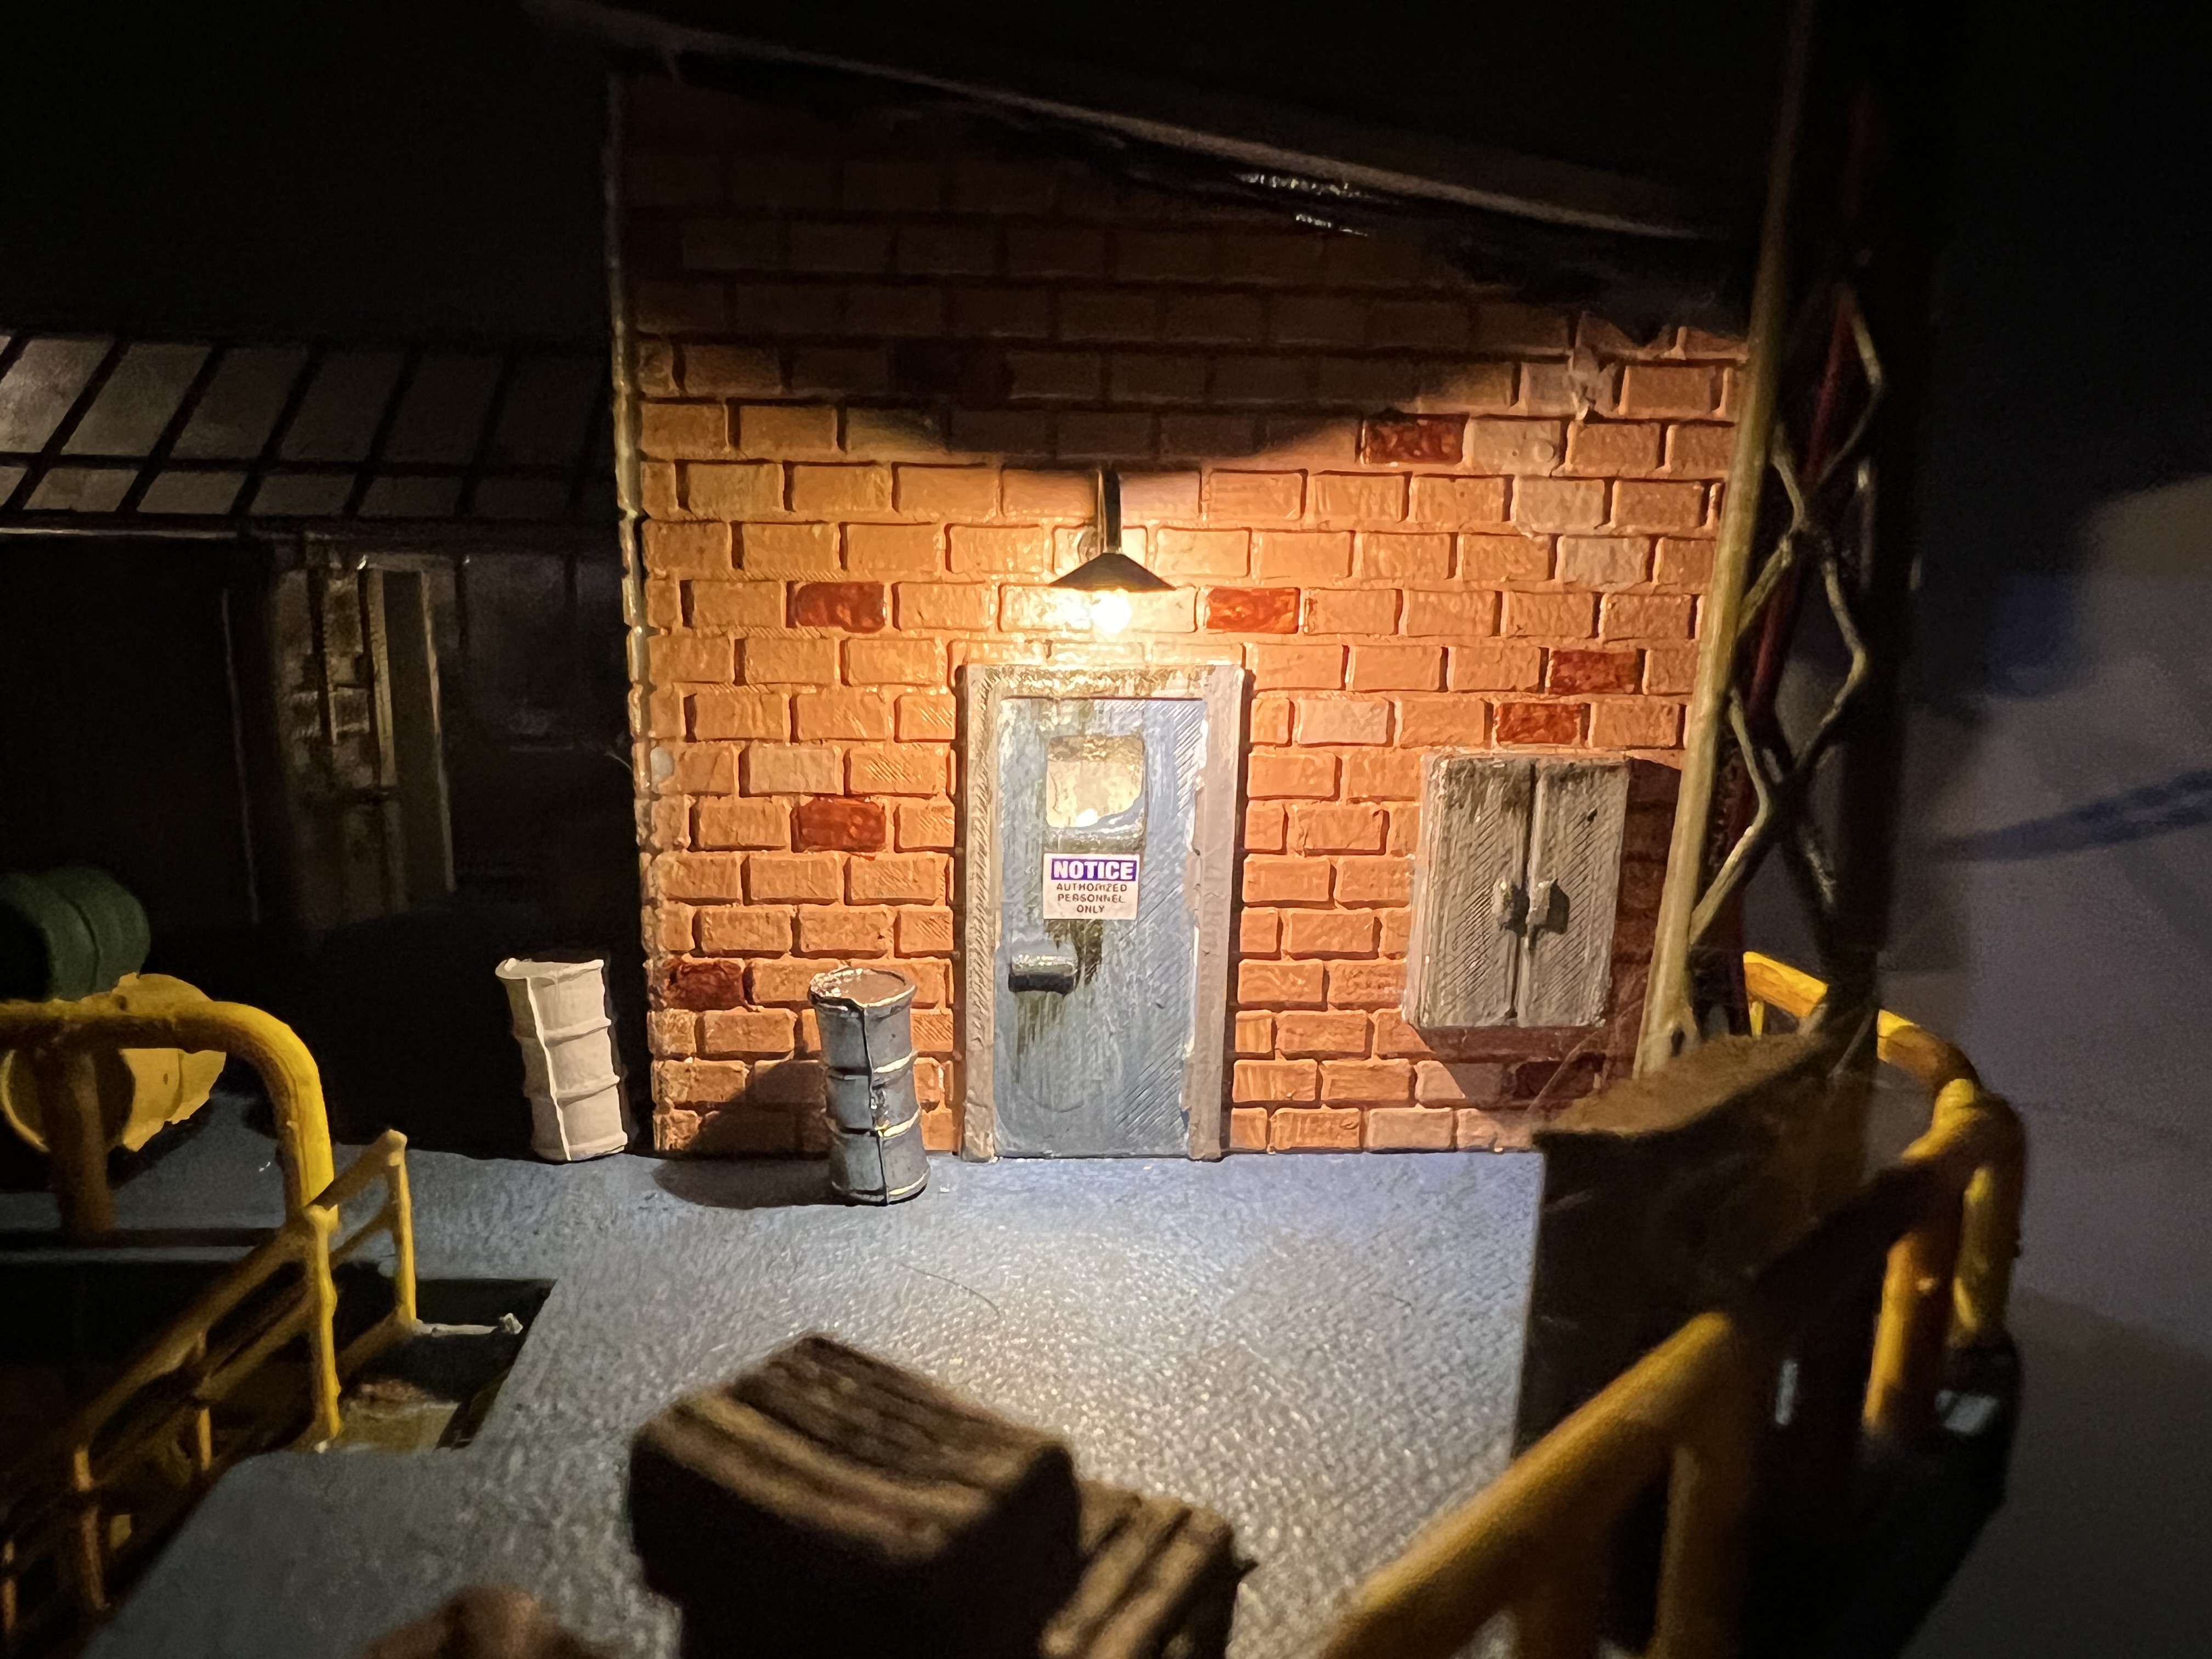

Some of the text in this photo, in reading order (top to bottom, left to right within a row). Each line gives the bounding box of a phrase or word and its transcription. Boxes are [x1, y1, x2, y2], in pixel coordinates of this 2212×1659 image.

[1053, 861, 1134, 880] NOTICE
[1057, 883, 1127, 892] AUTHORIZED
[1058, 893, 1125, 903] PERSONNEL
[1076, 905, 1105, 913] ONLY
